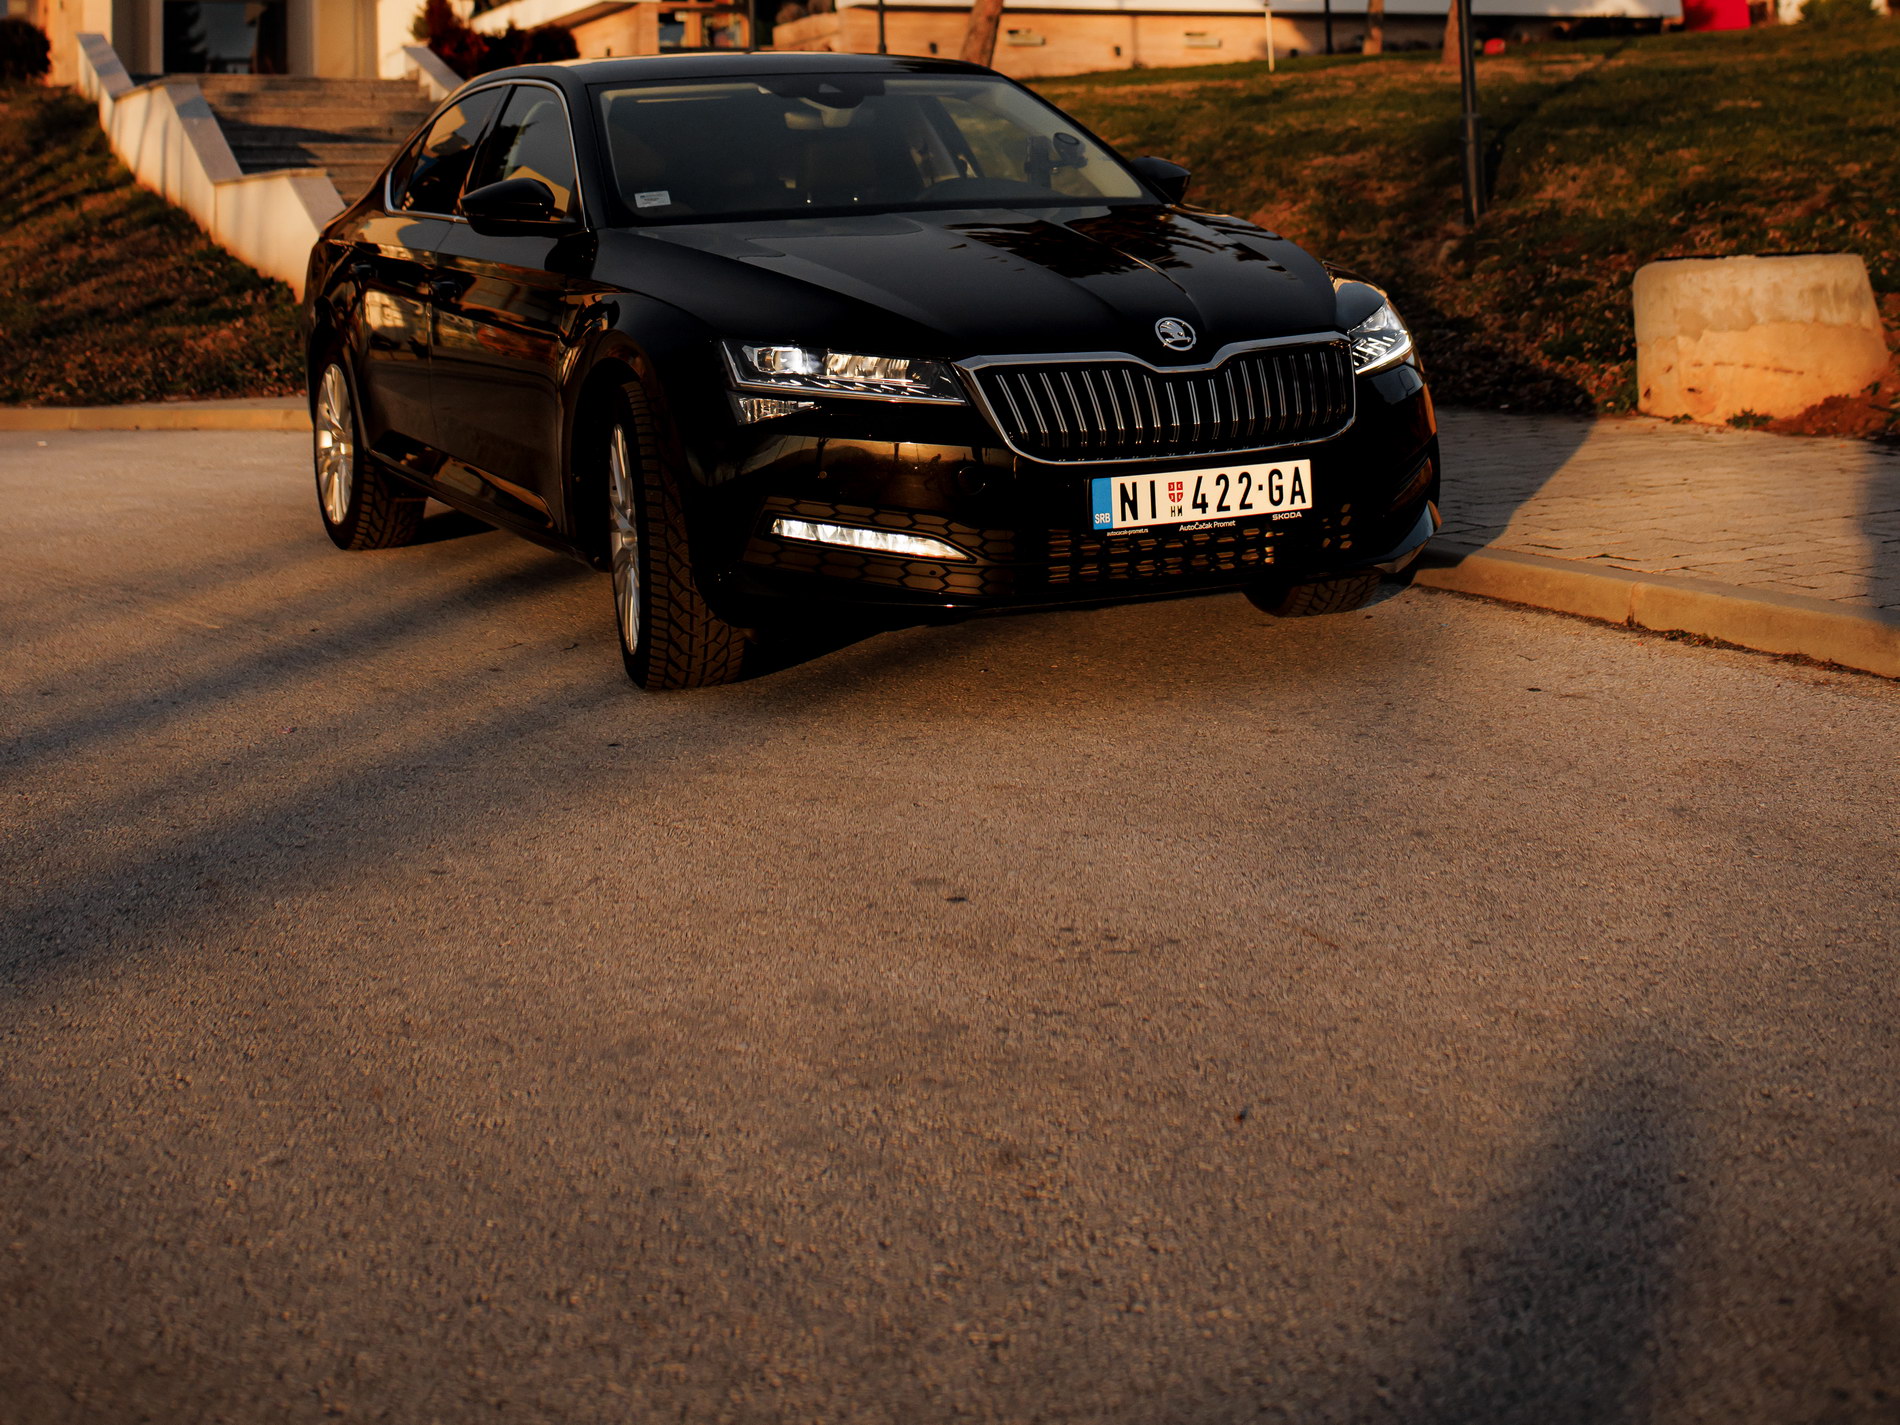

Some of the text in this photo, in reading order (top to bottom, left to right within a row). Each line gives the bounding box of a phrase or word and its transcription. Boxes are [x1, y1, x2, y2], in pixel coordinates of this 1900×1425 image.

[1119, 480, 1157, 522] NI
[1094, 512, 1111, 524] SRB
[1213, 519, 1236, 529] Promet
